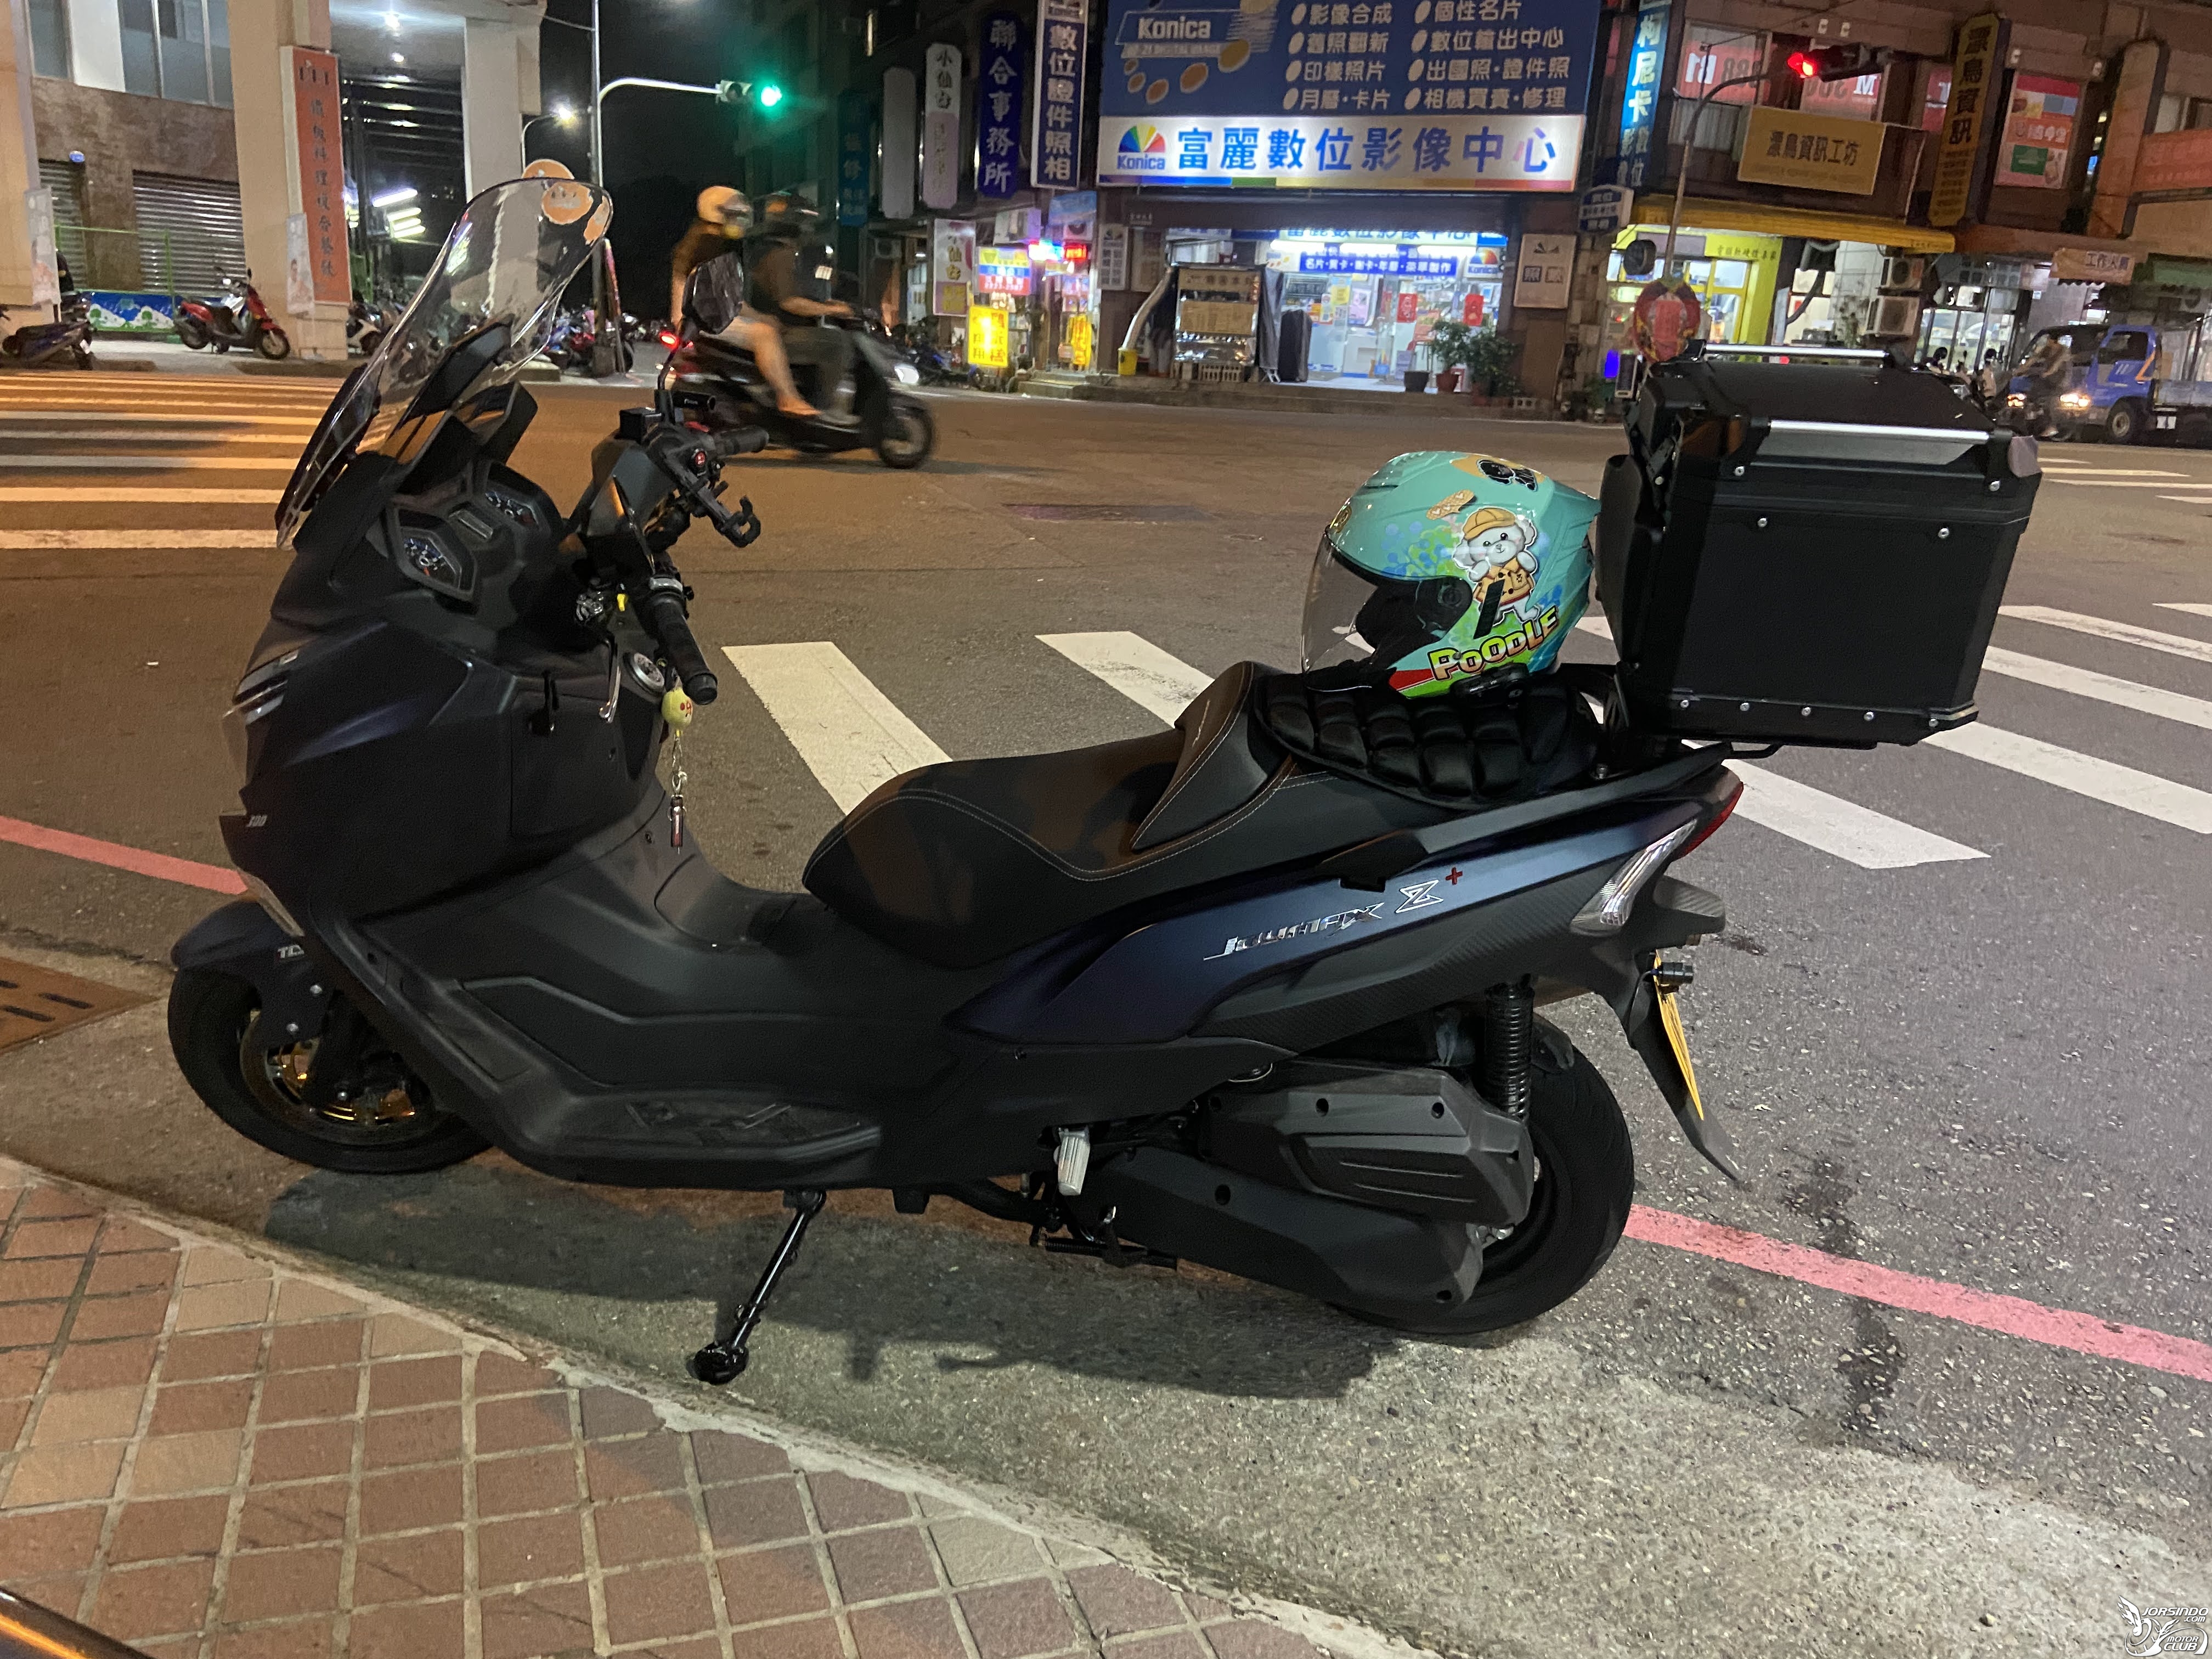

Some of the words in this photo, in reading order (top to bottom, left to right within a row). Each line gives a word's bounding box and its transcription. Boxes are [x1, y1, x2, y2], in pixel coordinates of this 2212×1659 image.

[1310, 3, 1392, 25] 影像合成
[1435, 0, 1522, 21] 個性名片
[1138, 16, 1211, 40] Konica
[1430, 27, 1564, 52] 數位輸出中心
[1178, 127, 1556, 173] 富麗數位影像中心
[1117, 155, 1165, 170] Konica
